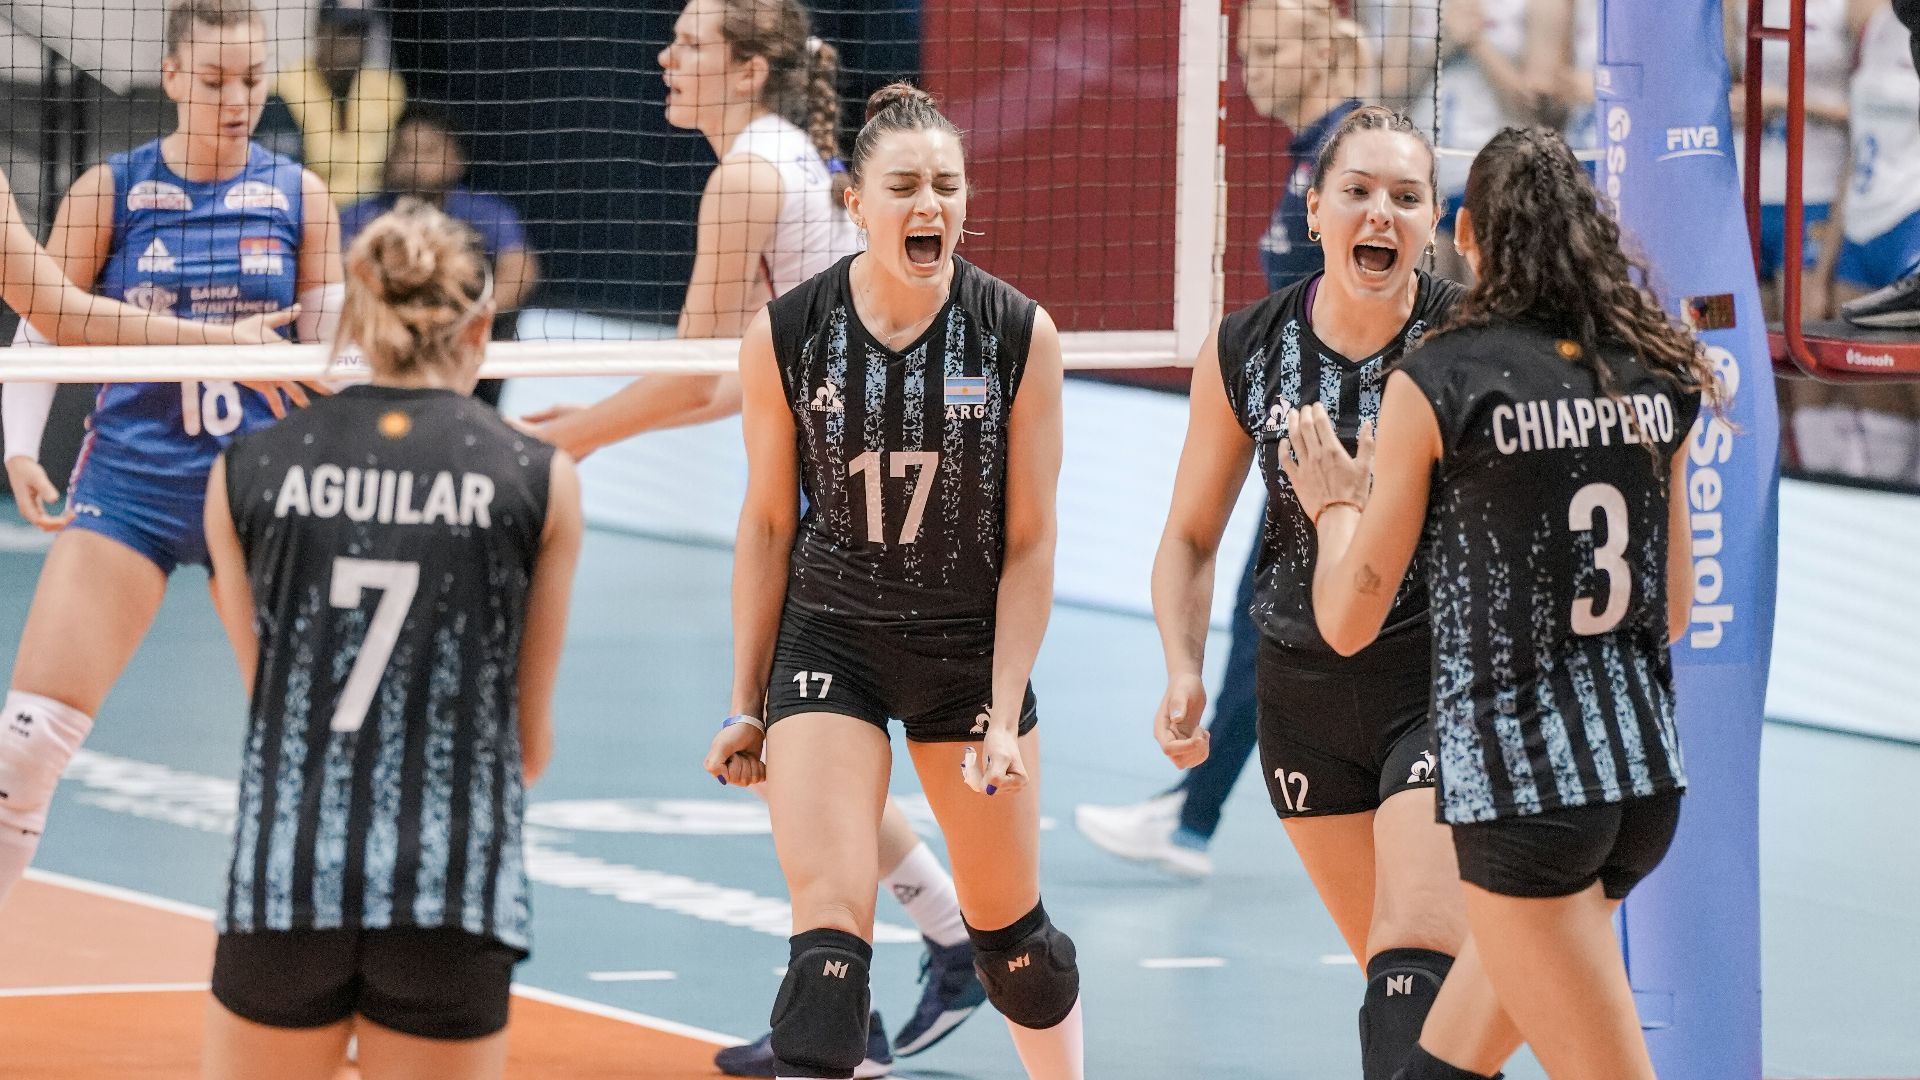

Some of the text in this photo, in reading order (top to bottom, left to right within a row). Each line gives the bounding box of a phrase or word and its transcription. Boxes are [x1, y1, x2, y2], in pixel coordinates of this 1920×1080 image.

[944, 404, 986, 420] ARG
[1492, 393, 1674, 455] CHIAPPERO
[274, 463, 496, 530] AGUILAR
[848, 451, 939, 545] 17
[1568, 482, 1632, 636] 3
[1689, 417, 1734, 649] Senoh
[329, 555, 421, 733] 7
[792, 670, 833, 699] 17
[1274, 767, 1312, 812] 12
